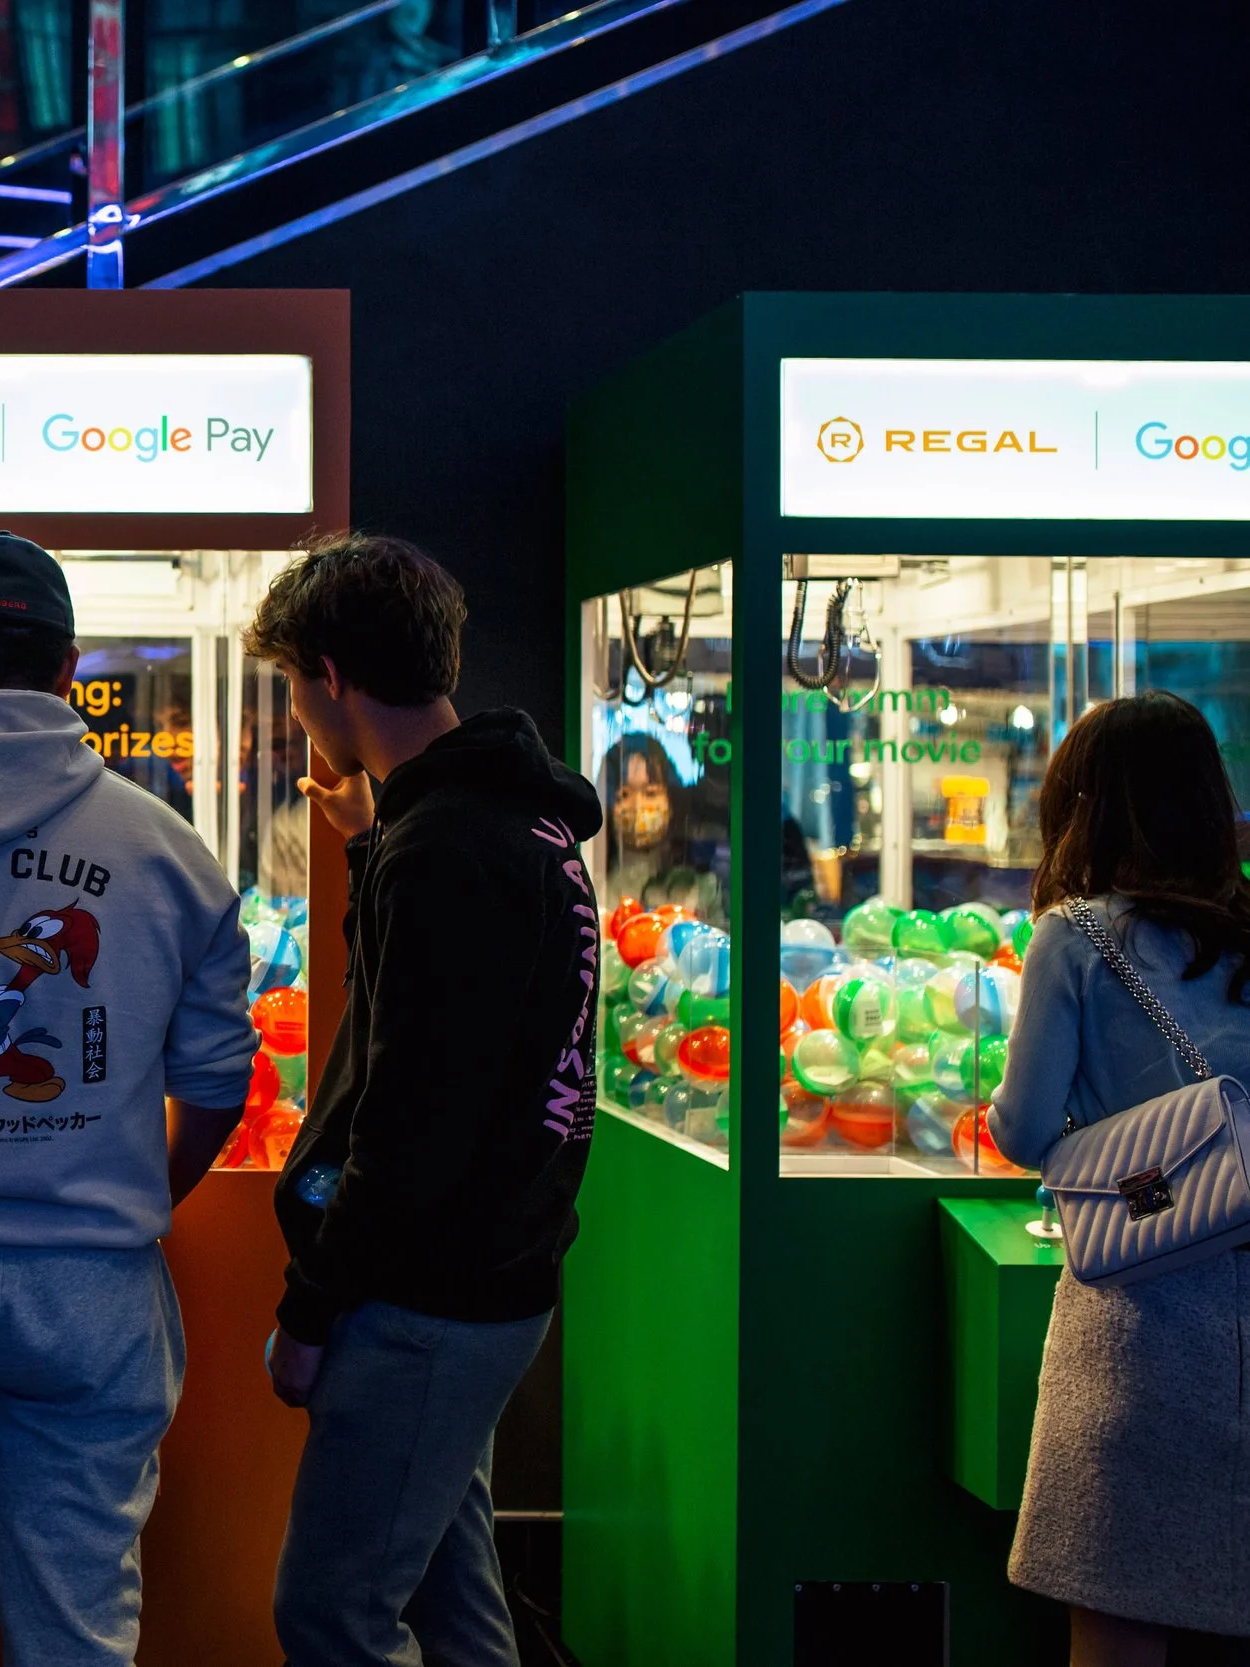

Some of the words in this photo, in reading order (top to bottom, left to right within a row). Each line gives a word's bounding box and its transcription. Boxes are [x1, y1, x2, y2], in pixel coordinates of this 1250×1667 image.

[42, 413, 192, 463] Google
[207, 417, 274, 462] Pay
[885, 430, 1058, 453] REGAL
[1135, 421, 1250, 472] Goog
[693, 731, 732, 765] fo
[782, 738, 852, 764] our
[862, 731, 982, 764] movie
[11, 848, 111, 897] CLUB
[85, 1008, 105, 1079] 暴動社会
